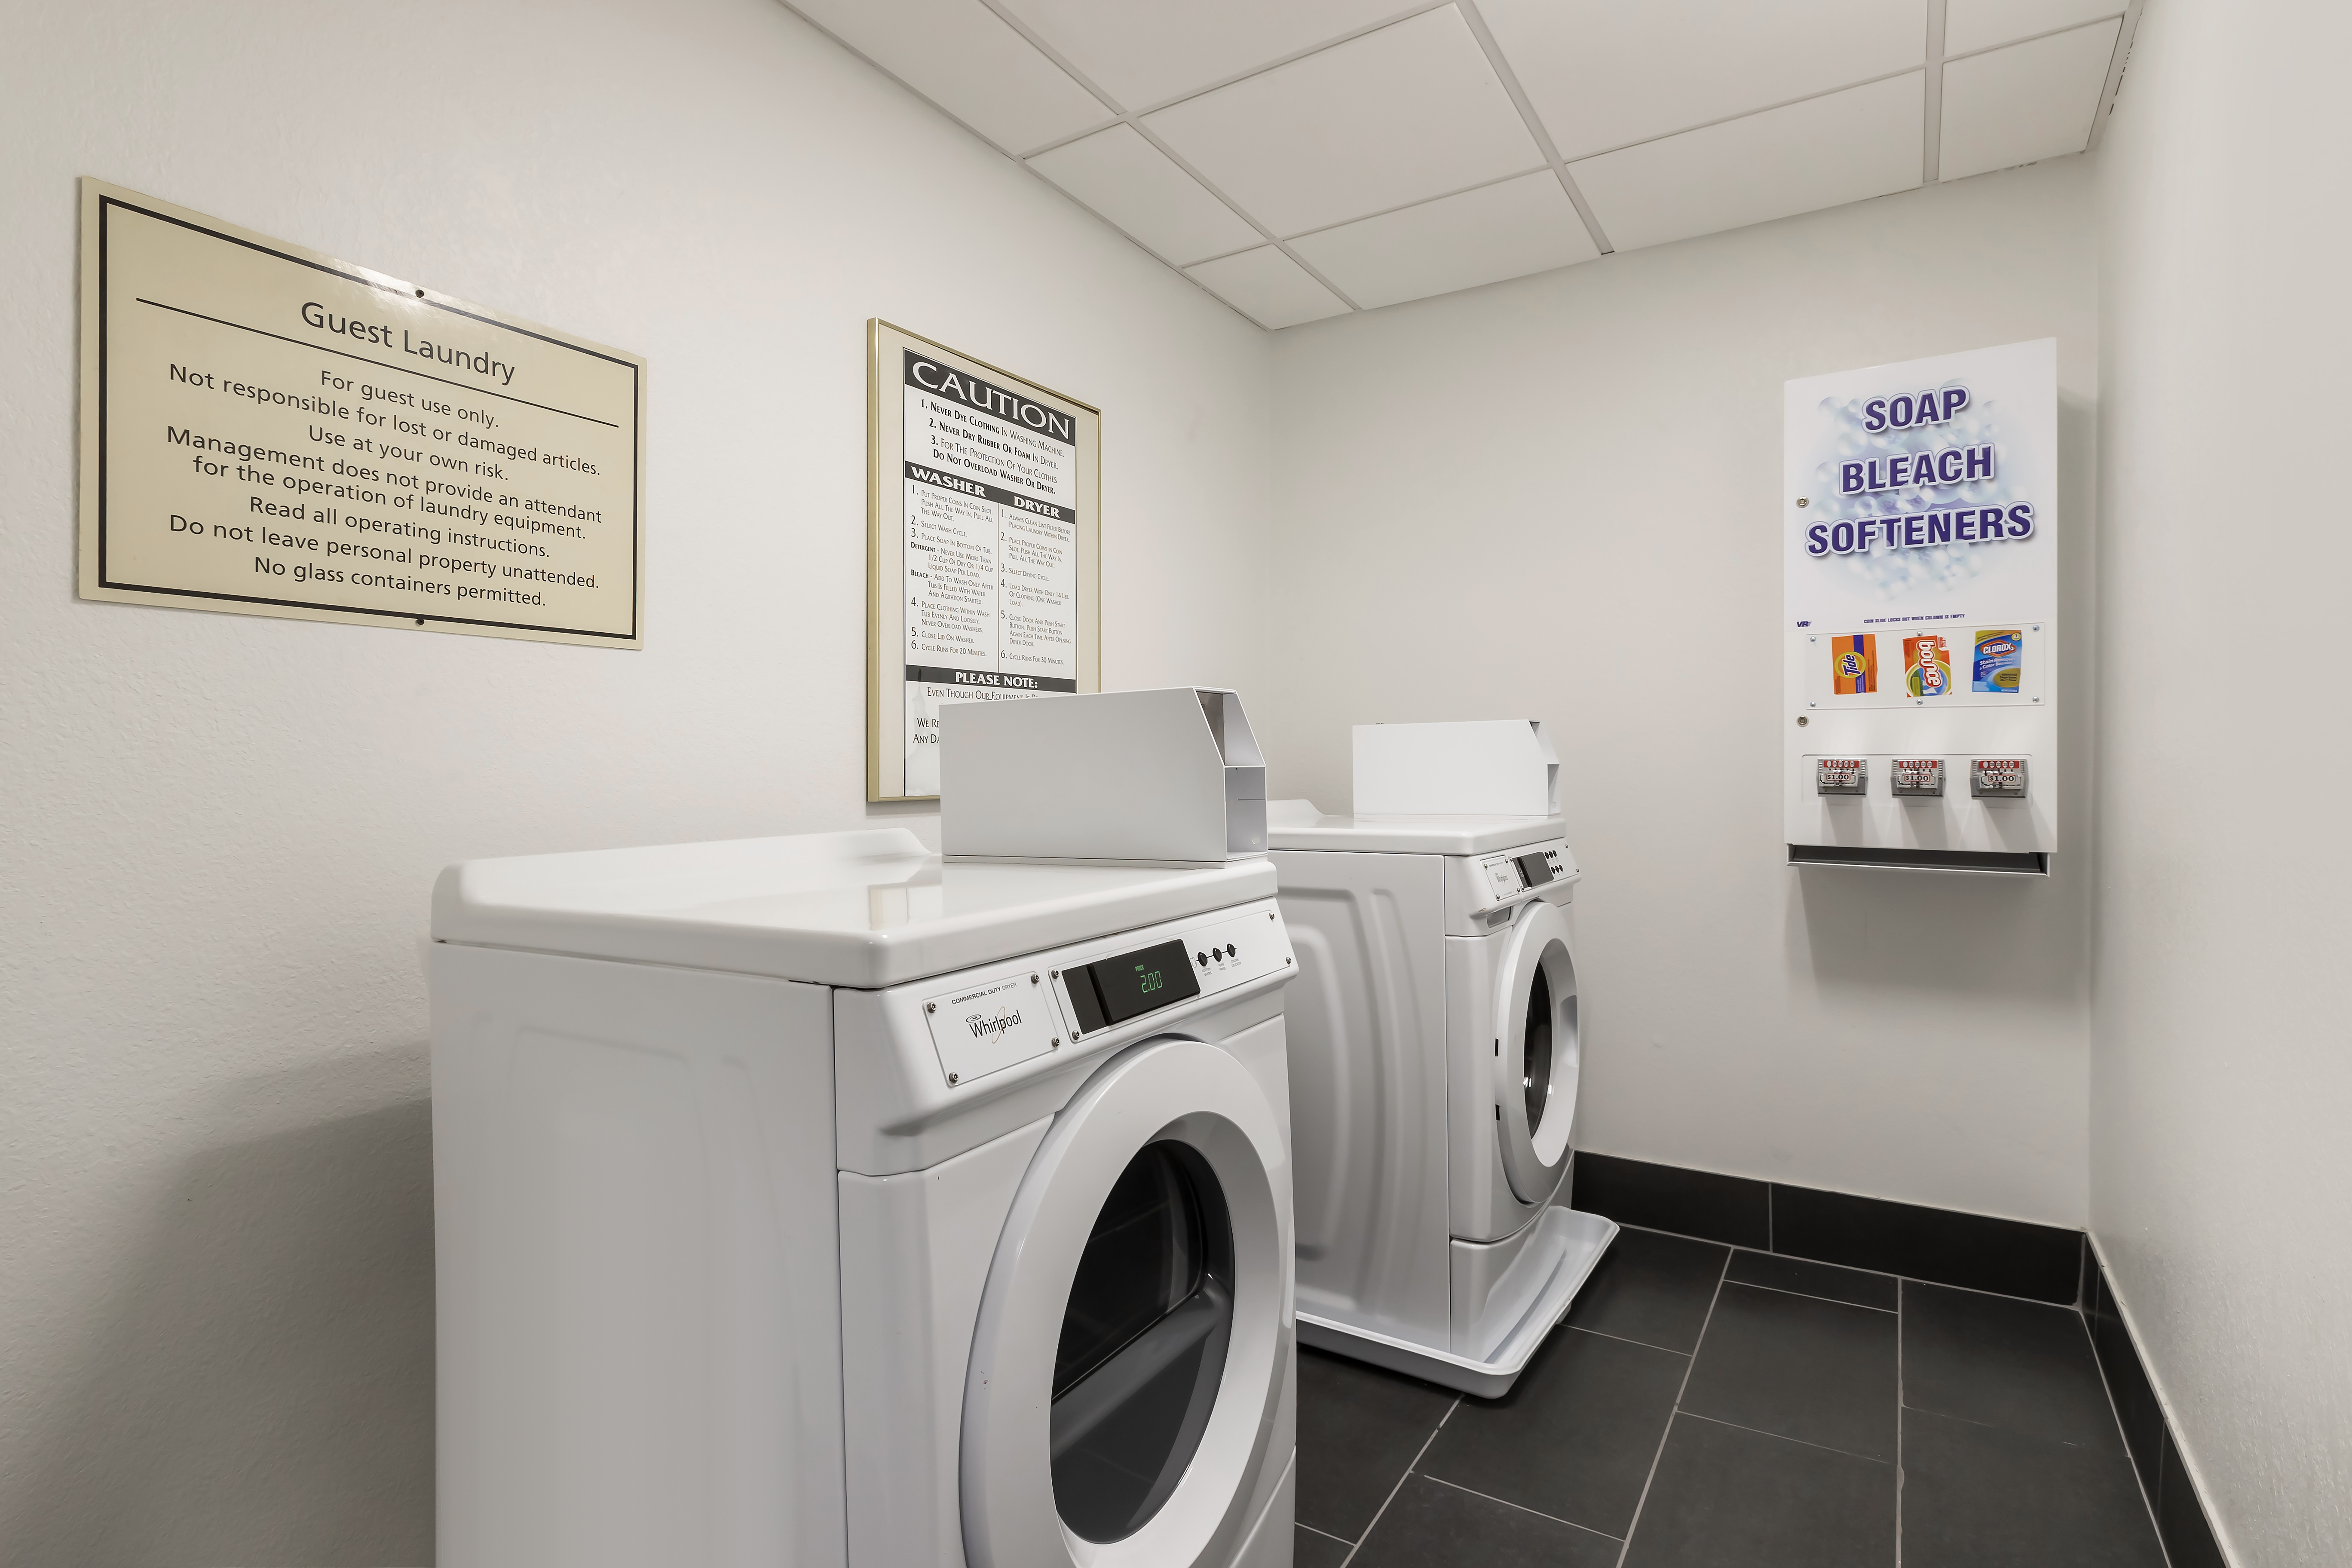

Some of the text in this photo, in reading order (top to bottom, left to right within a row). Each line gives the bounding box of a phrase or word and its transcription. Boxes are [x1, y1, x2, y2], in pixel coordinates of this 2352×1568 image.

[301, 301, 515, 386] Guest Laundry
[170, 363, 600, 475] Not responsible for lost or damaged articles.
[321, 370, 499, 429] For guest use only.
[913, 362, 1069, 439] CAUTION
[1864, 387, 1968, 432] SOAP
[167, 426, 602, 523] Management does not provide an attendant
[309, 424, 508, 480] Use at your own risk.
[1841, 444, 1993, 494] BLEACH
[192, 455, 585, 539] for the operation of laundry equipment.
[911, 466, 986, 497] WASHER
[250, 496, 549, 557] Read all operating instructions.
[911, 515, 918, 525] 2.
[1014, 496, 1060, 518] DRYER
[1807, 502, 2032, 555] SOFTENERS
[170, 514, 598, 588] Do not leave personal property unattended.
[911, 527, 918, 538] 3.
[255, 556, 545, 606] No glass containers permitted.
[1001, 563, 1007, 573] 3.
[911, 627, 918, 637] 5.
[911, 639, 918, 649] 6.
[1001, 649, 1007, 658] 6.
[1843, 655, 1861, 676] Tide
[1918, 640, 1941, 686] bounce
[952, 991, 987, 1004] COMMERCIAL
[1001, 982, 1017, 990] DRYER
[1140, 971, 1163, 993] 2.00
[969, 1009, 1022, 1038] Whirlpool
